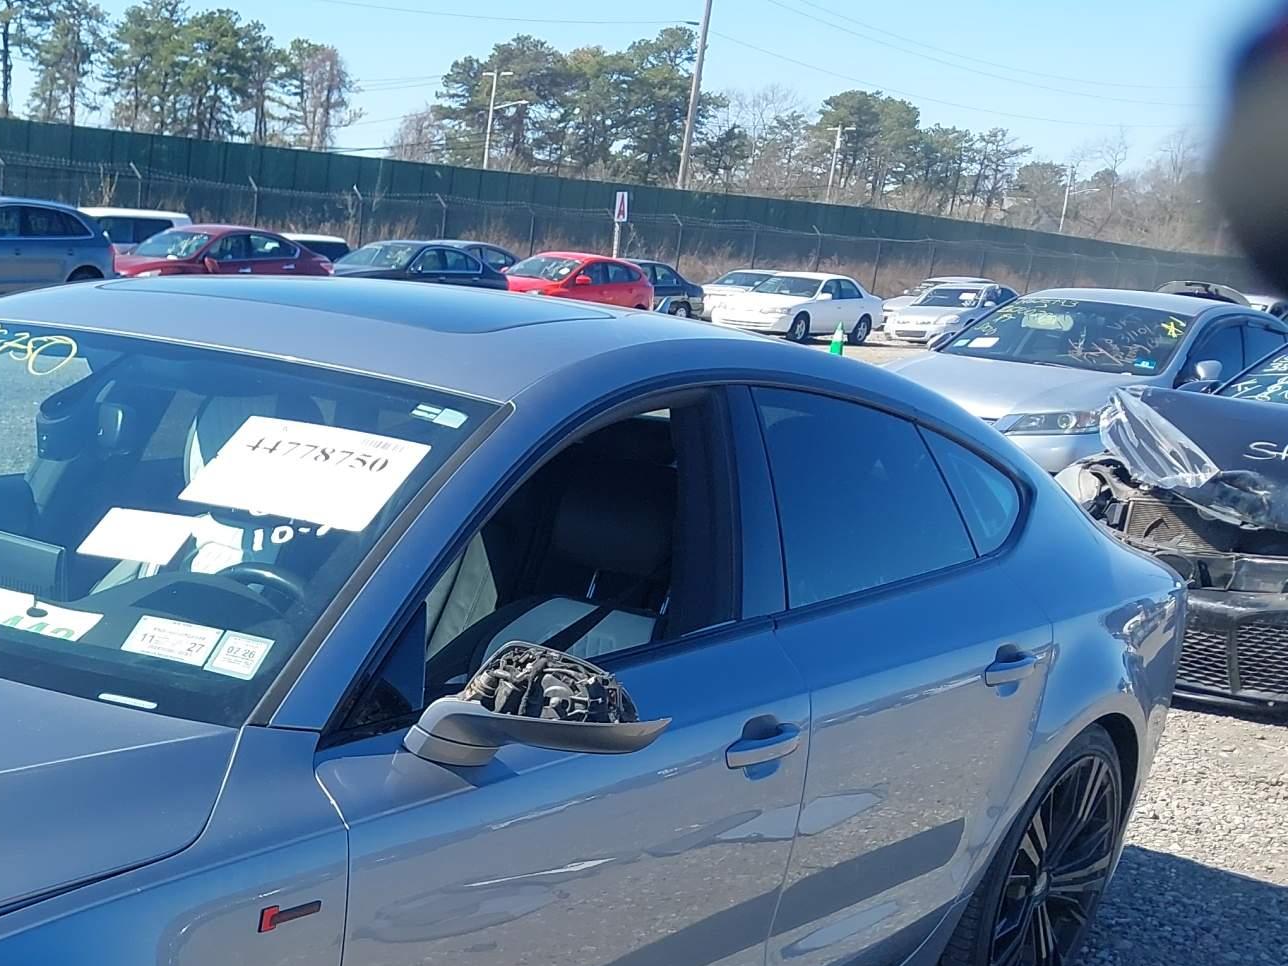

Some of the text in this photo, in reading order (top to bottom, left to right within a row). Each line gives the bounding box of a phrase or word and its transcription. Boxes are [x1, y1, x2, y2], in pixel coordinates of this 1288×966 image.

[616, 192, 626, 219] A
[246, 437, 390, 473] 44778750
[186, 641, 206, 654] 27
